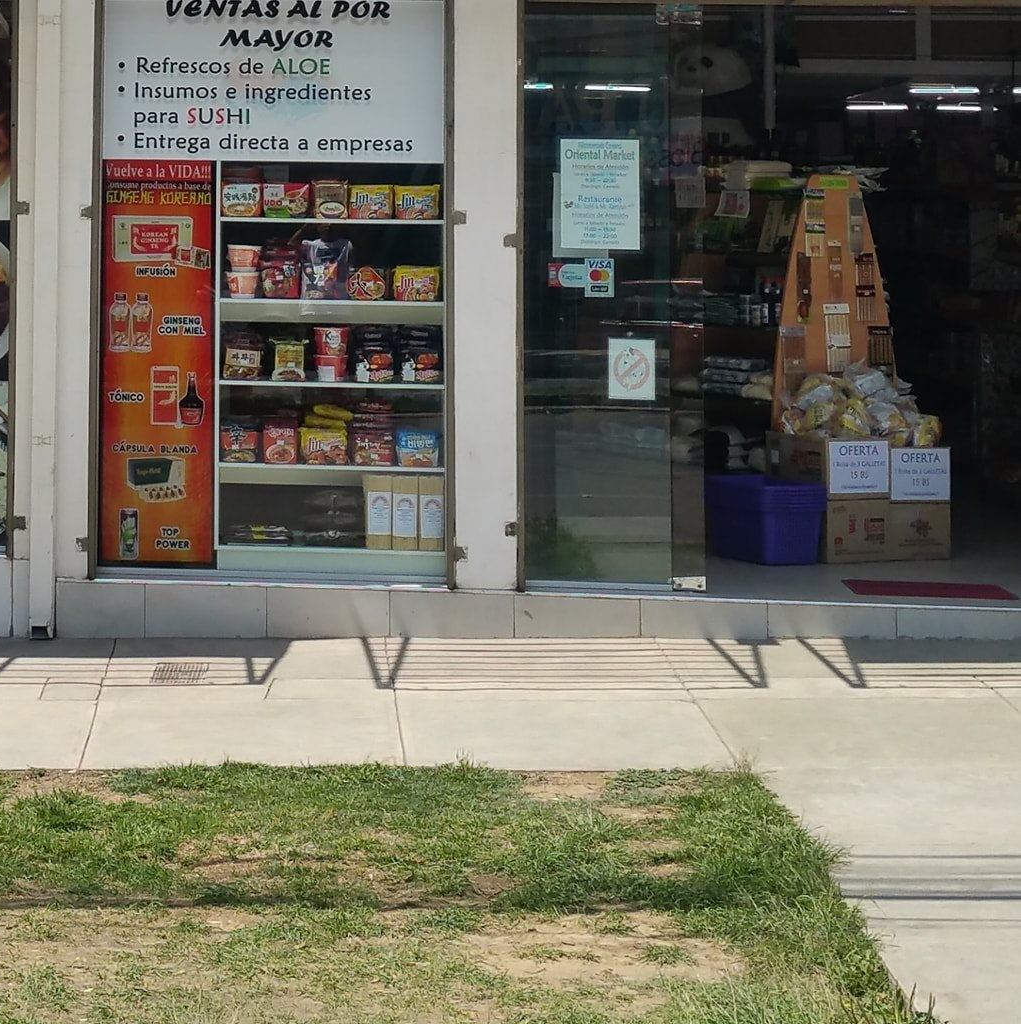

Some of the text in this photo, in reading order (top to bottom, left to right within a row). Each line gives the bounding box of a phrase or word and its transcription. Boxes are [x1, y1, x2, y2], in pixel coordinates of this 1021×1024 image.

[166, 0, 391, 19] VENTAS AL POR
[219, 30, 334, 52] MAYOR
[136, 57, 331, 76] Refrescos de ALOE
[134, 82, 371, 104] Insumos e ingredientes
[133, 109, 251, 129] para SUSHI
[134, 133, 413, 156] Entrega directa a empresas
[564, 148, 636, 161] Oriental Market
[106, 163, 212, 179] Vuelve a la VIDA!!!
[106, 190, 212, 206] GINSENG KOREANO
[136, 264, 177, 276] INFUSIÓN
[588, 260, 612, 269] VISA
[163, 316, 201, 325] GINSENG
[159, 326, 206, 335] CON MIEL
[109, 388, 144, 402] TÓNICO
[113, 441, 198, 454] CÁPSULA BLANDA
[839, 445, 879, 457] OFERTA
[901, 453, 941, 464] OFERTA
[850, 471, 858, 479] 15
[912, 478, 920, 487] 15
[161, 527, 179, 536] TOP
[155, 540, 190, 550] POWER
